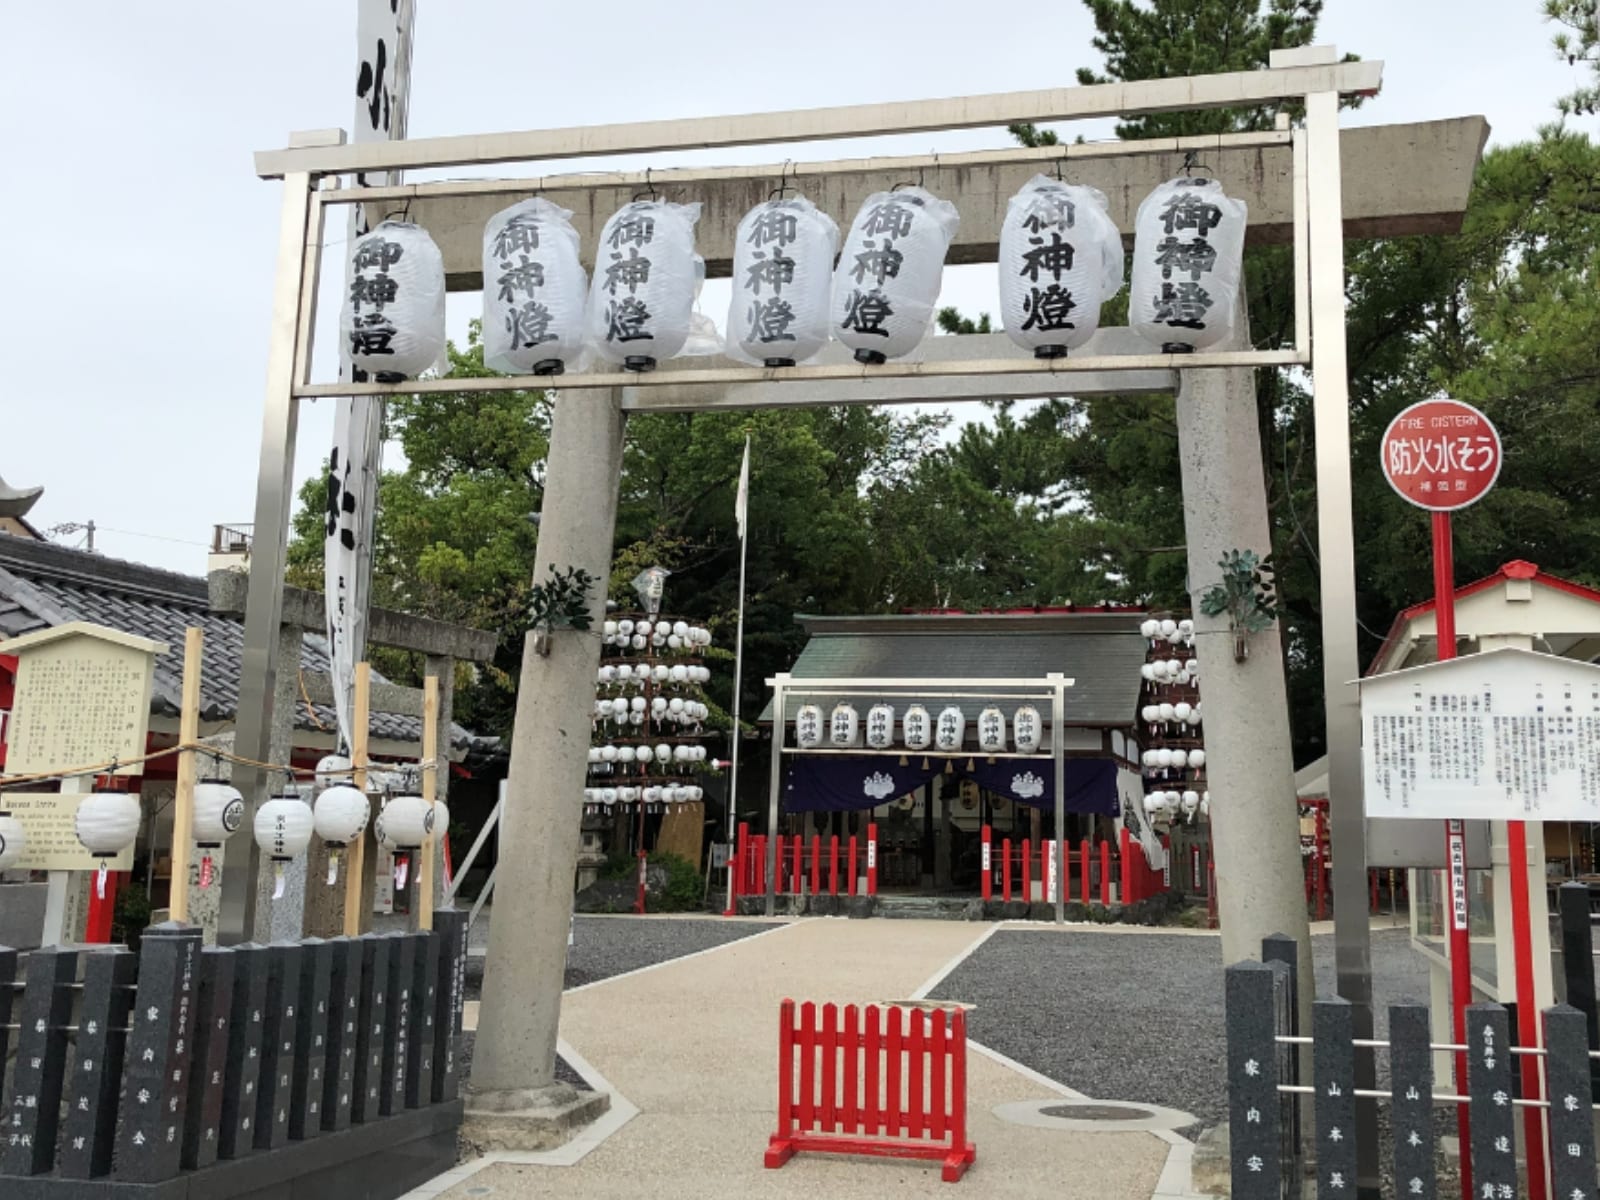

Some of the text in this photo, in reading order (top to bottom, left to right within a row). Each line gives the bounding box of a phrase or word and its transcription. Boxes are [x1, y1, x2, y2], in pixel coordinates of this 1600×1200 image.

[348, 236, 404, 357] 御神燈
[493, 212, 559, 352] 御神燈
[602, 211, 655, 344] 御神燈
[744, 210, 798, 345] 御神燈
[841, 196, 915, 337] 御神燈
[1019, 190, 1077, 333] 御神燈
[1152, 190, 1223, 331] 御神燈
[1389, 434, 1495, 477] 防火水そう
[1400, 415, 1479, 430] FIRE CISTERN
[132, 1005, 159, 1145] 家内安全
[1483, 1023, 1496, 1071] 春日井市
[1244, 1058, 1264, 1173] 家内安
